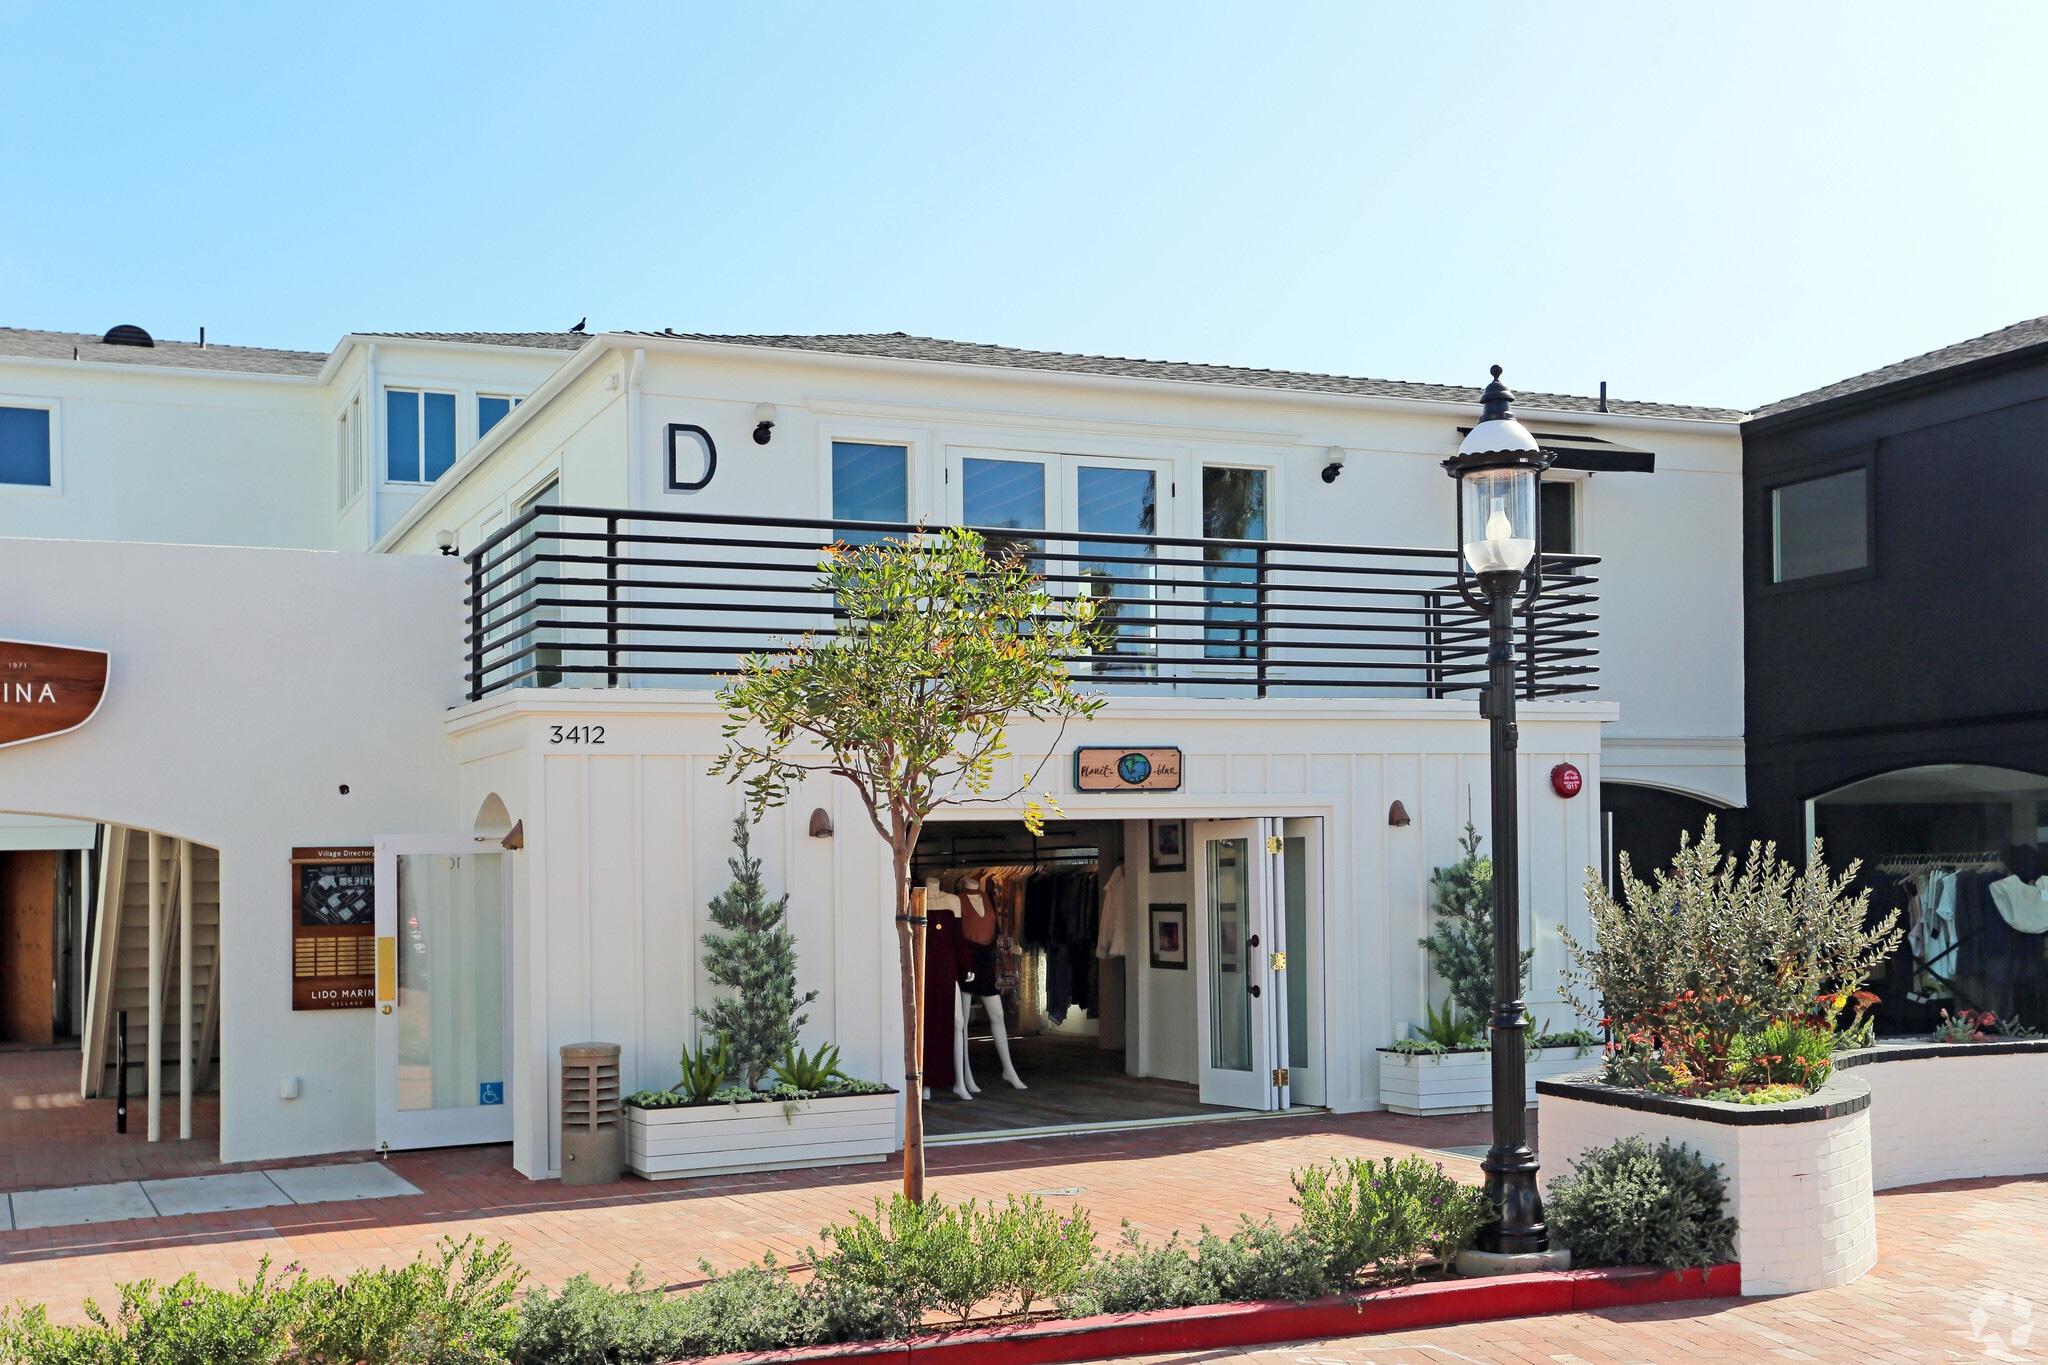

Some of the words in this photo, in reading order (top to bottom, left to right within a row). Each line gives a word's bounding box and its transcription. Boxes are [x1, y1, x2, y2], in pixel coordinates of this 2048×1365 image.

[668, 423, 717, 490] D
[4, 682, 56, 703] INA
[550, 725, 605, 744] 3412
[317, 850, 342, 858] Village
[311, 990, 338, 1000] LIDO
